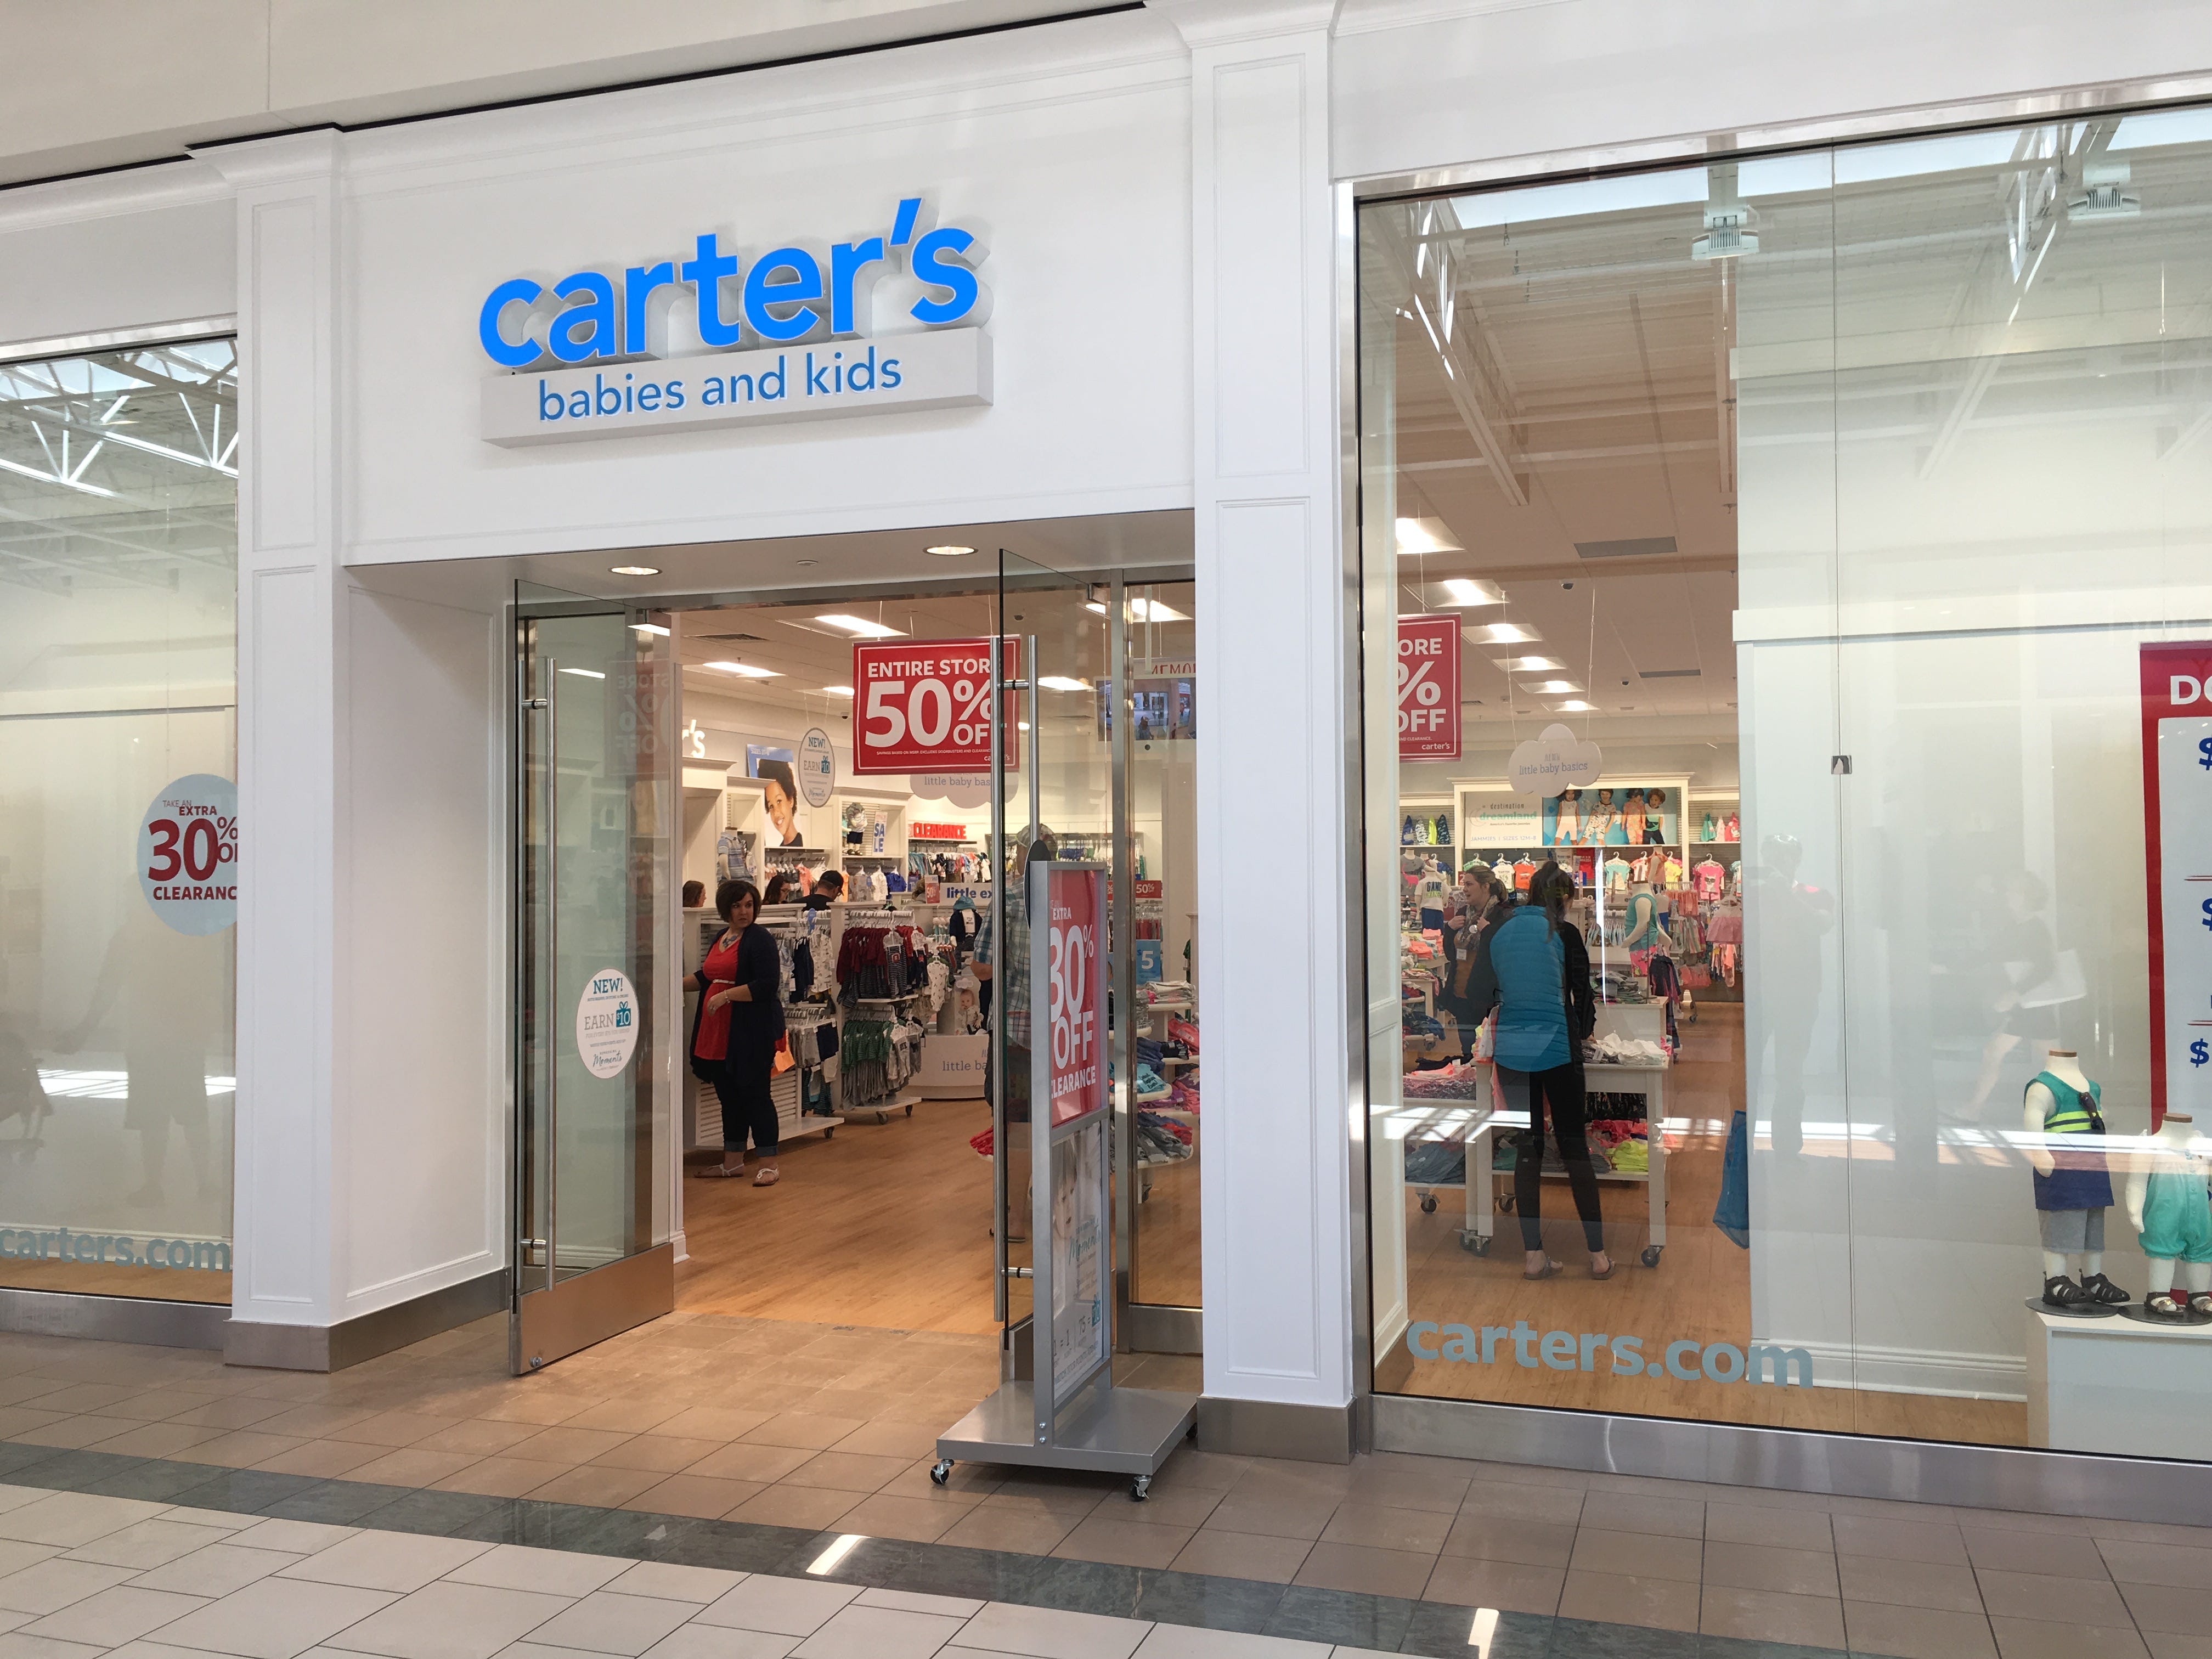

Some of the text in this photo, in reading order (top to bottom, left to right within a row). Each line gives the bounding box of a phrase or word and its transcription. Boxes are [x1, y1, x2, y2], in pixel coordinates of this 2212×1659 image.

[479, 198, 978, 367] carter's
[539, 347, 902, 422] babies and kids
[868, 658, 991, 678] ENTIRE STOR
[865, 678, 991, 747] 50%
[953, 723, 990, 745] OF
[808, 737, 826, 748] NEW!
[1519, 762, 1588, 775] little baby basics
[924, 776, 991, 788] little baby bas
[162, 800, 179, 808] TAKE
[179, 805, 217, 816] EXTRA
[1480, 811, 1537, 820] dreamland
[913, 822, 967, 839] CLEARANCE
[148, 816, 238, 882] 30%
[154, 886, 237, 900] CLEARANC
[947, 887, 977, 899] little
[1427, 882, 1442, 891] GAME
[1053, 907, 1071, 920] EXTRA
[593, 978, 623, 994] NEW!
[584, 1011, 630, 1030] EARN $10
[1054, 1011, 1093, 1069] OFF
[942, 1060, 988, 1071] little ba
[1052, 1065, 1096, 1099] LEARANCE
[0, 1227, 231, 1273] carters.com
[1406, 1321, 1813, 1389] carters.com
